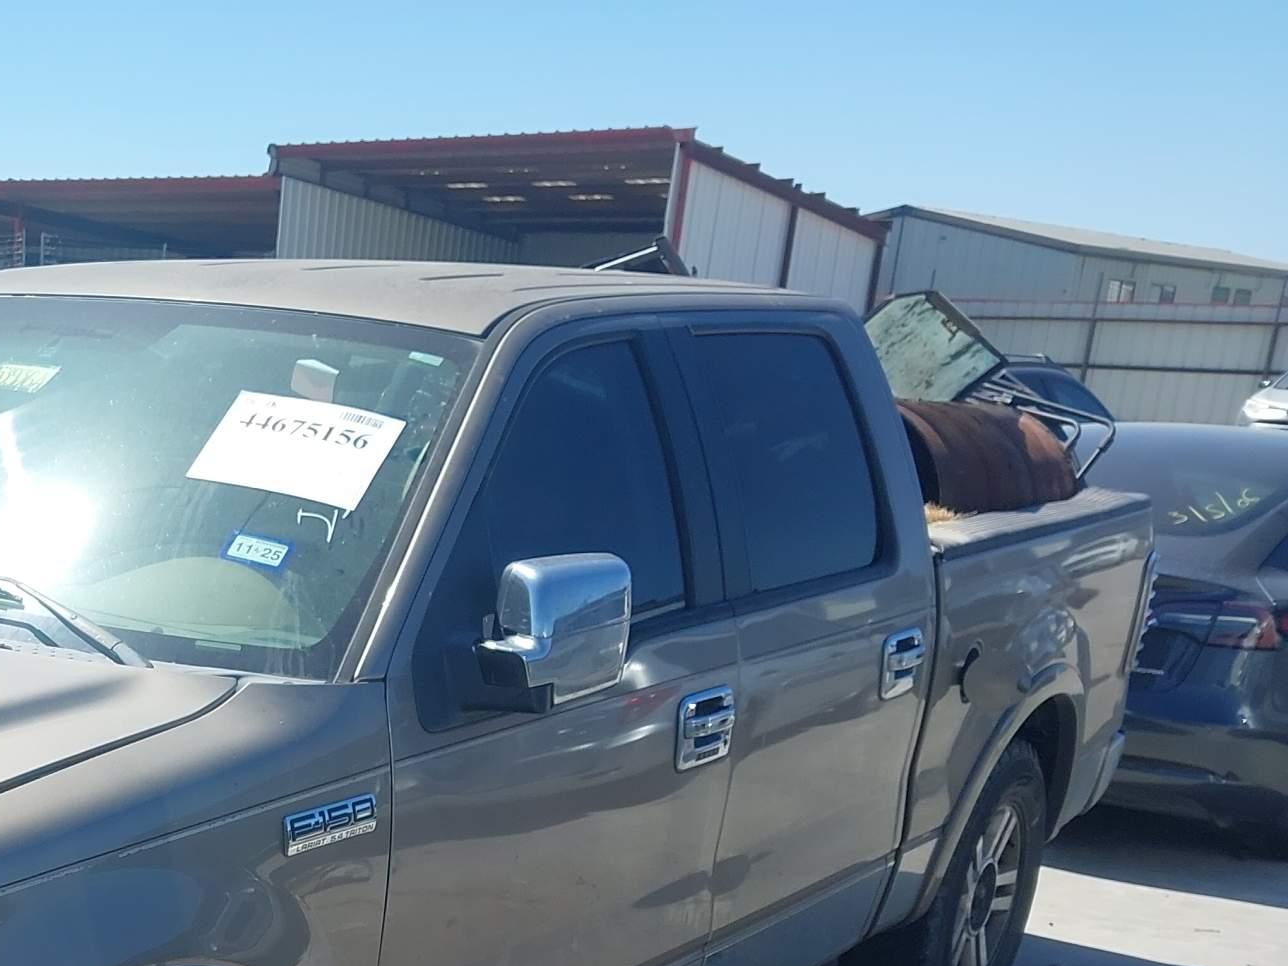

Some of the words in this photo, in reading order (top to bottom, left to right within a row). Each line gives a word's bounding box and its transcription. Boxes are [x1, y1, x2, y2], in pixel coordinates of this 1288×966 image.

[240, 413, 374, 450] 44675156
[236, 542, 254, 556] 11
[261, 547, 283, 561] 25
